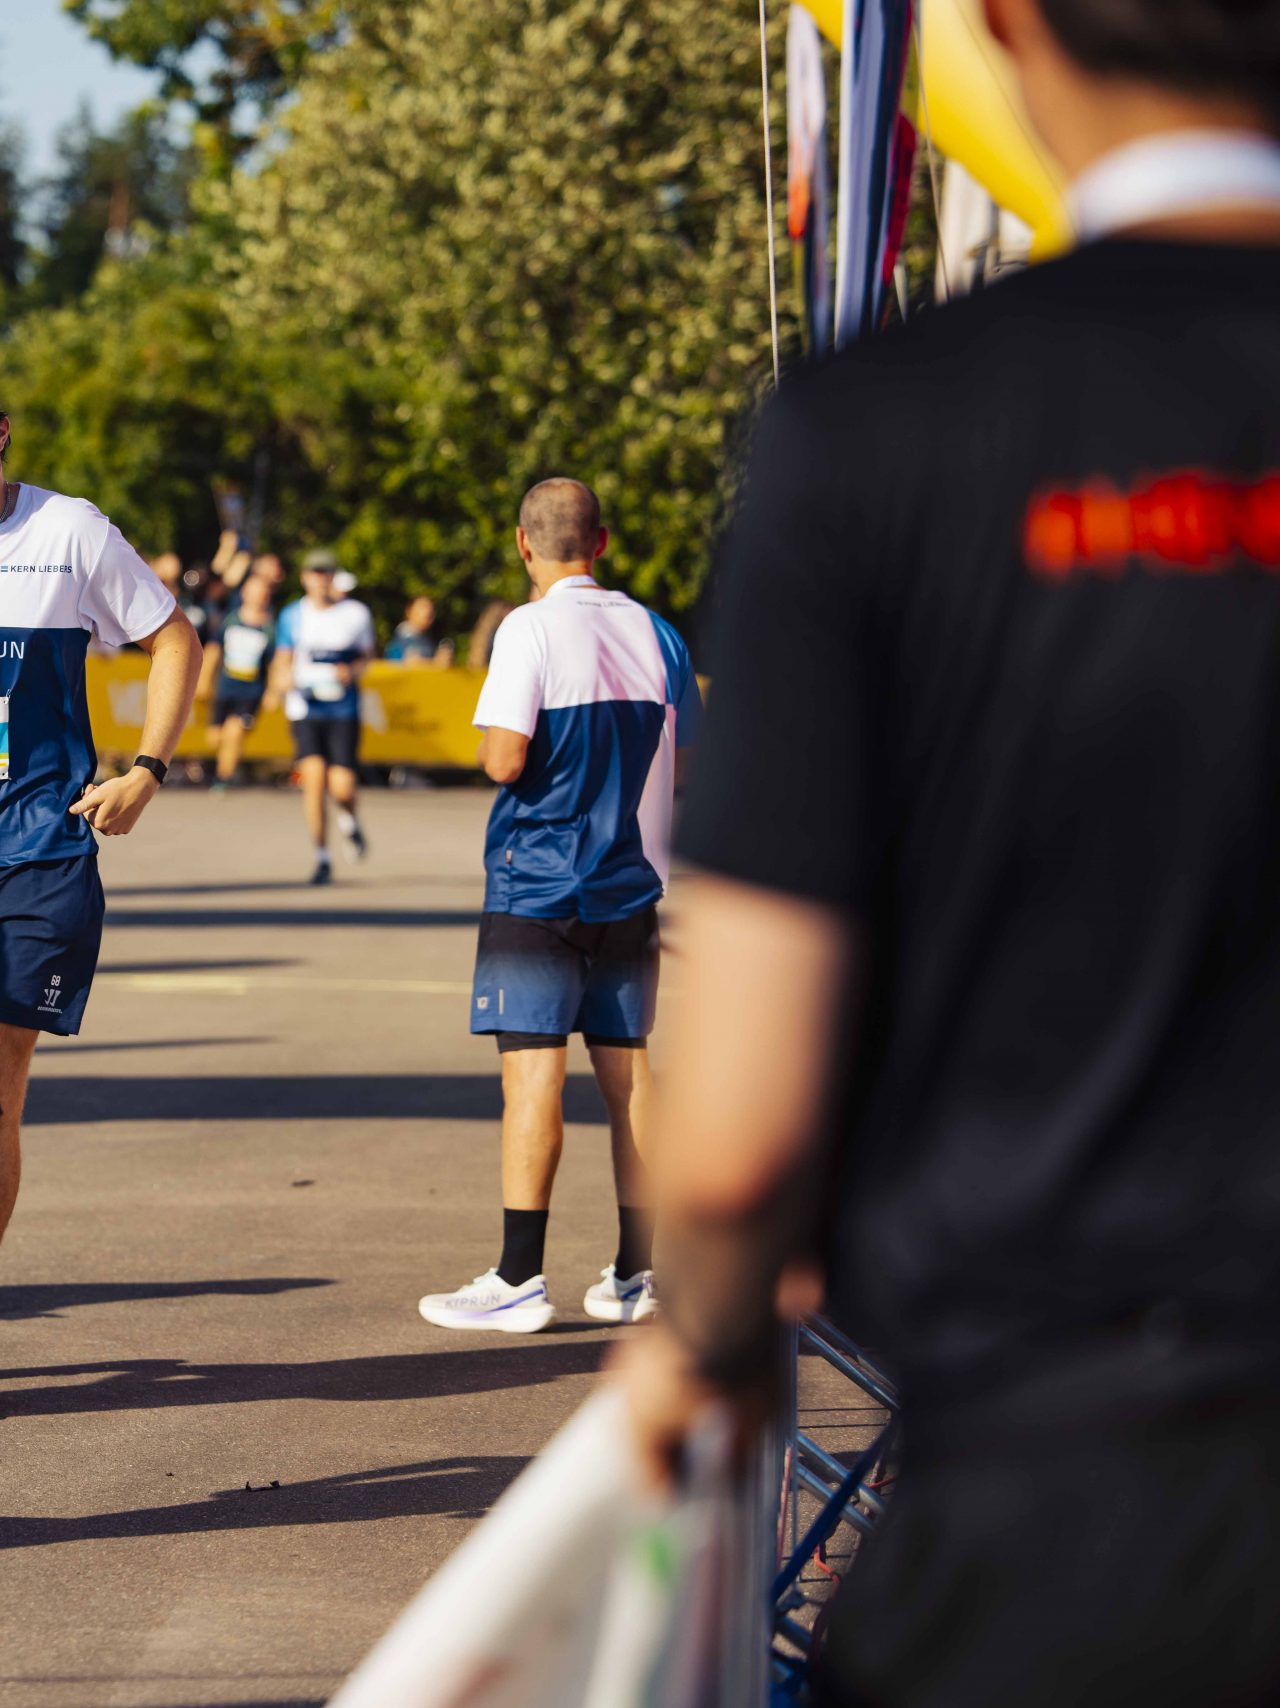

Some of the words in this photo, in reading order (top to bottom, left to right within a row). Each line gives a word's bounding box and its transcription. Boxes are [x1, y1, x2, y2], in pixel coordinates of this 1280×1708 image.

[10, 565, 36, 573] KERN
[38, 565, 73, 574] LIEBERS
[445, 1294, 501, 1309] KIPRUN
